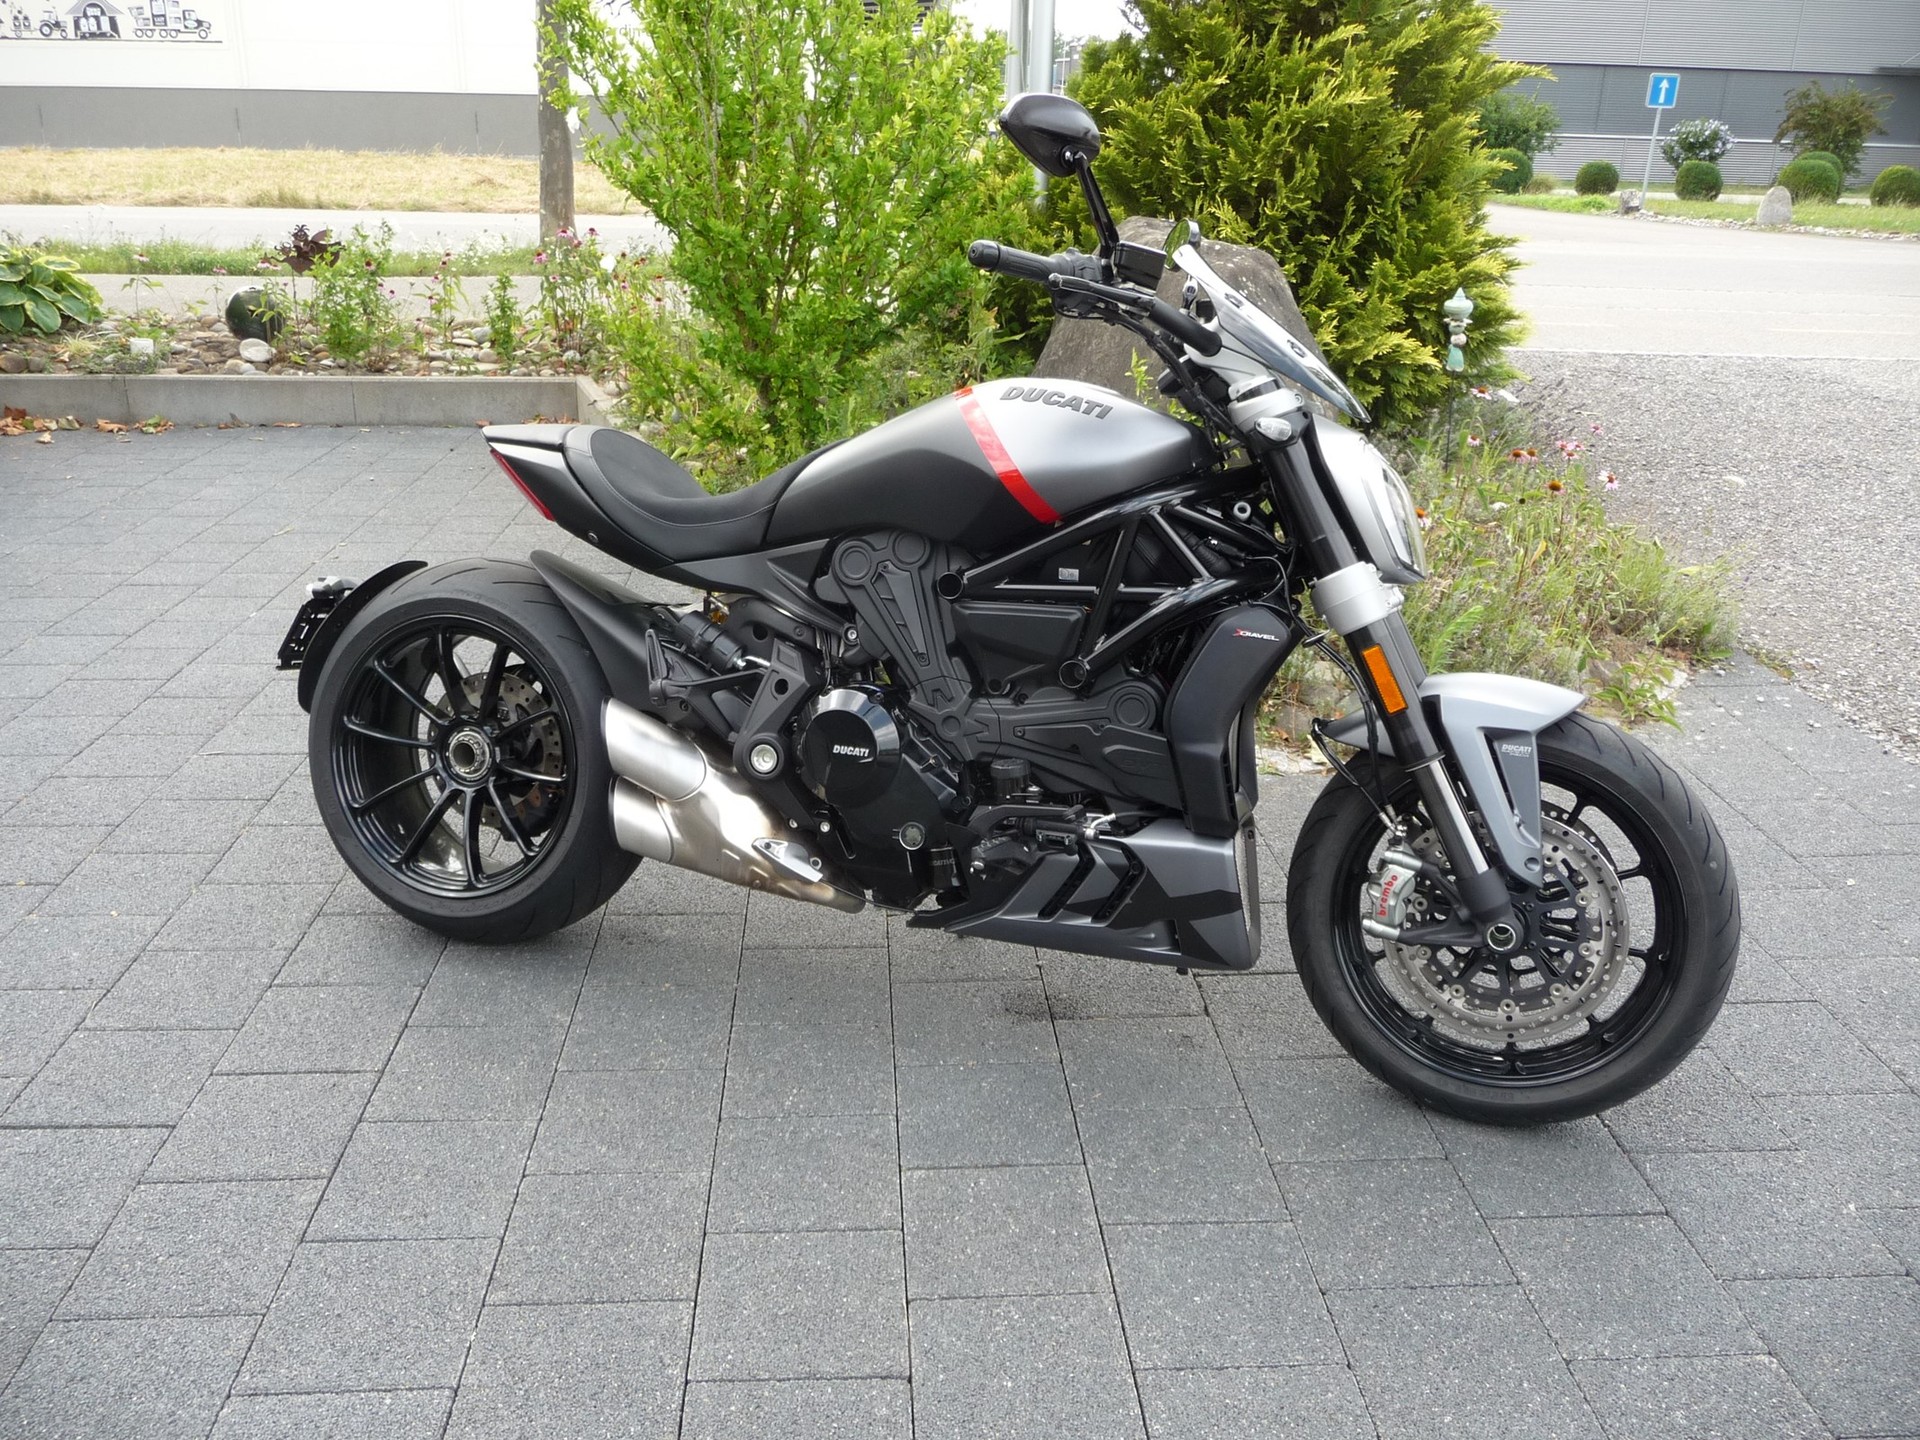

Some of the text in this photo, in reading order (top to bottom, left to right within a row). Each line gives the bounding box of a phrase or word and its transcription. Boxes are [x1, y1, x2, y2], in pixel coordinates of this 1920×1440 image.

[999, 386, 1114, 420] DUCATI
[1232, 627, 1280, 642] XDIAVEL
[832, 744, 870, 757] DUCATI
[1501, 744, 1532, 753] DUCATI
[1376, 875, 1398, 917] brembo
